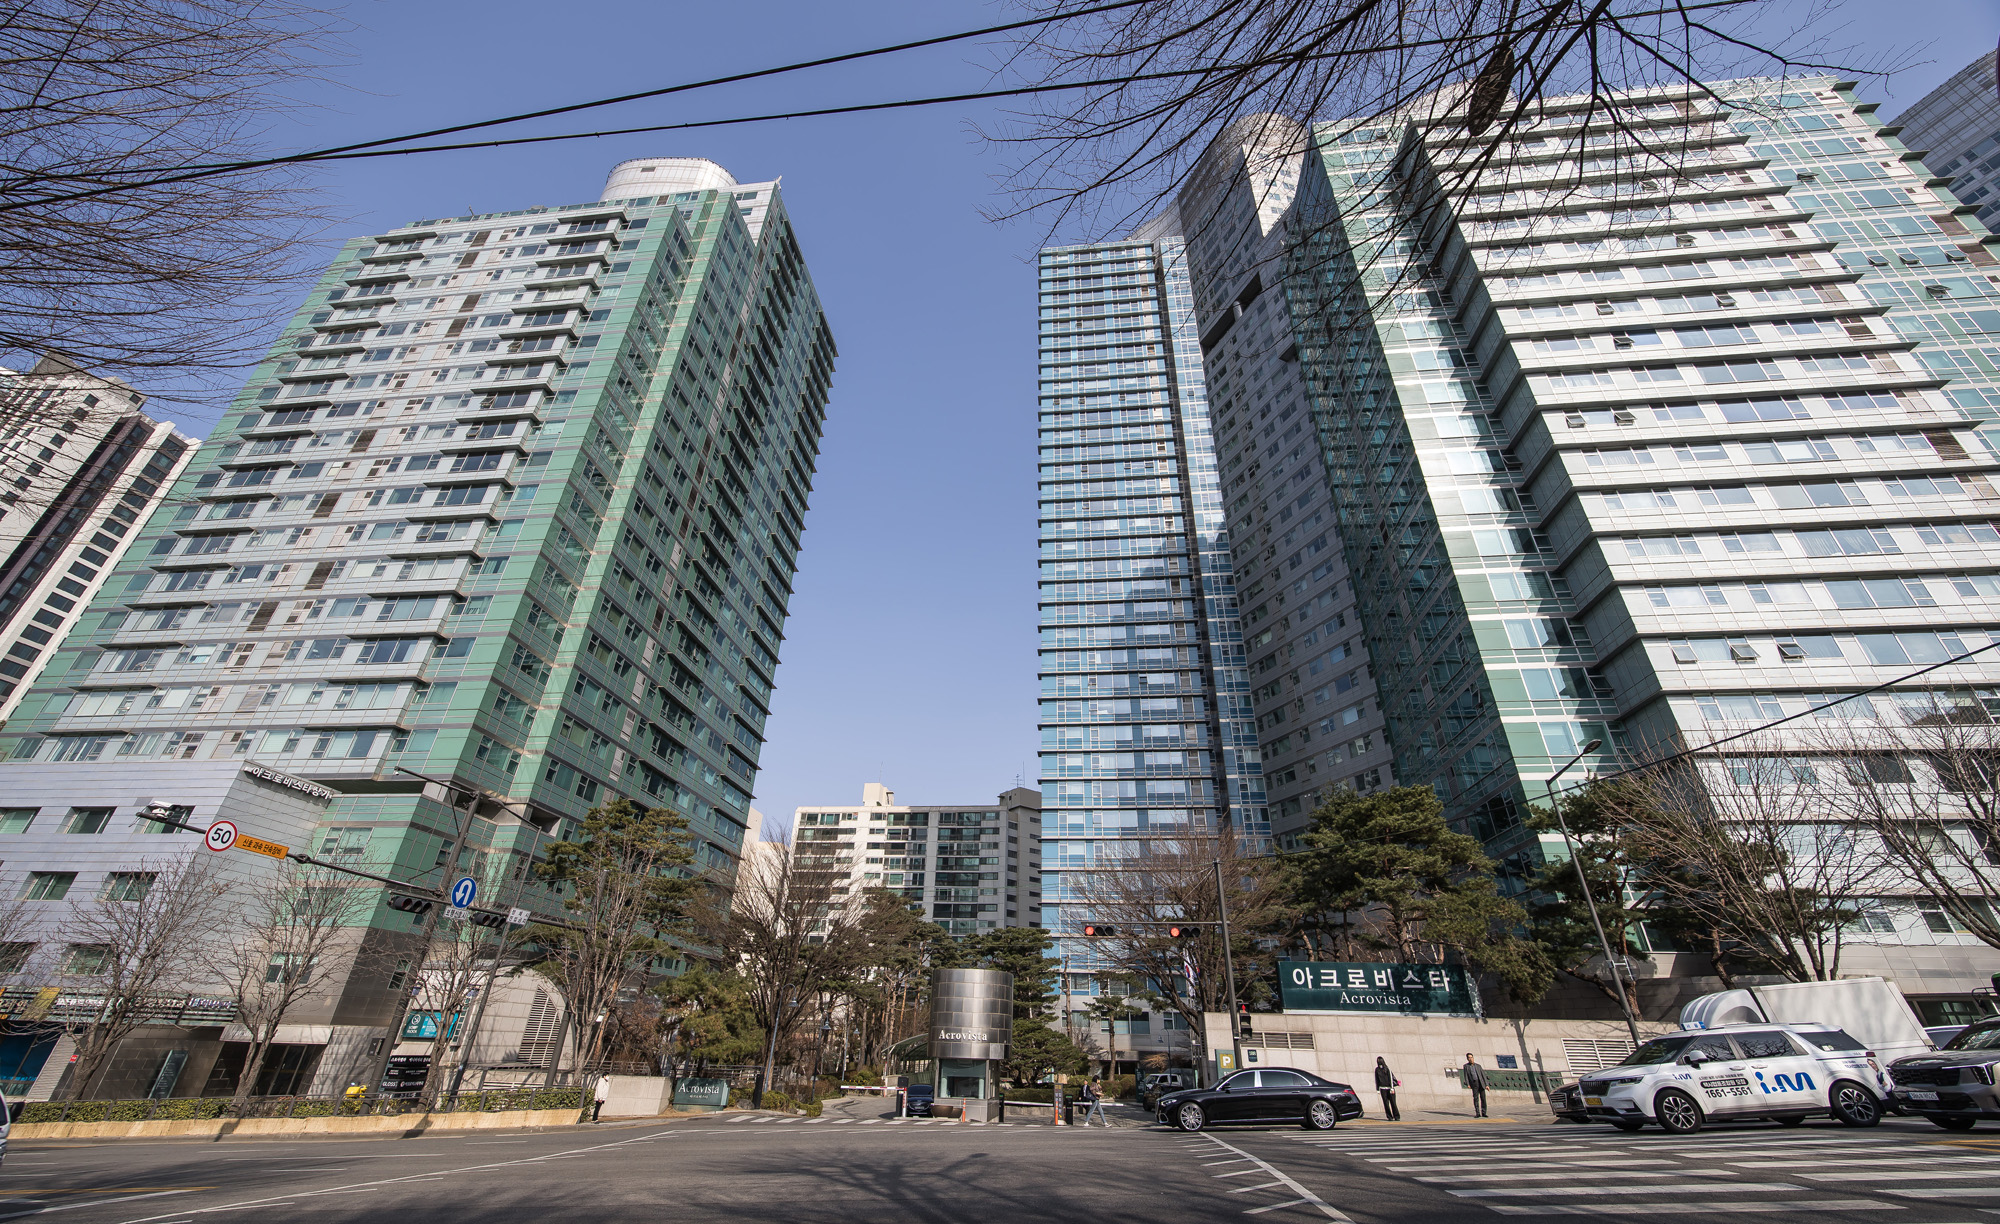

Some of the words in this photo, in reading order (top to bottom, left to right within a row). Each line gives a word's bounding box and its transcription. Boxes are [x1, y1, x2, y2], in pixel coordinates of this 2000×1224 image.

[252, 767, 330, 800] 아크로비스타상가
[211, 828, 232, 844] 50
[242, 838, 253, 848] 신호
[253, 841, 264, 851] 과속
[263, 844, 283, 856] 단속장비
[1292, 967, 1450, 992] 아크로비스타
[1340, 991, 1411, 1005] Acrovista
[938, 1029, 988, 1041] Acrovista
[1222, 1056, 1231, 1067] P
[678, 1082, 720, 1094] Acrovista
[1705, 1086, 1753, 1098] 1661-5561
